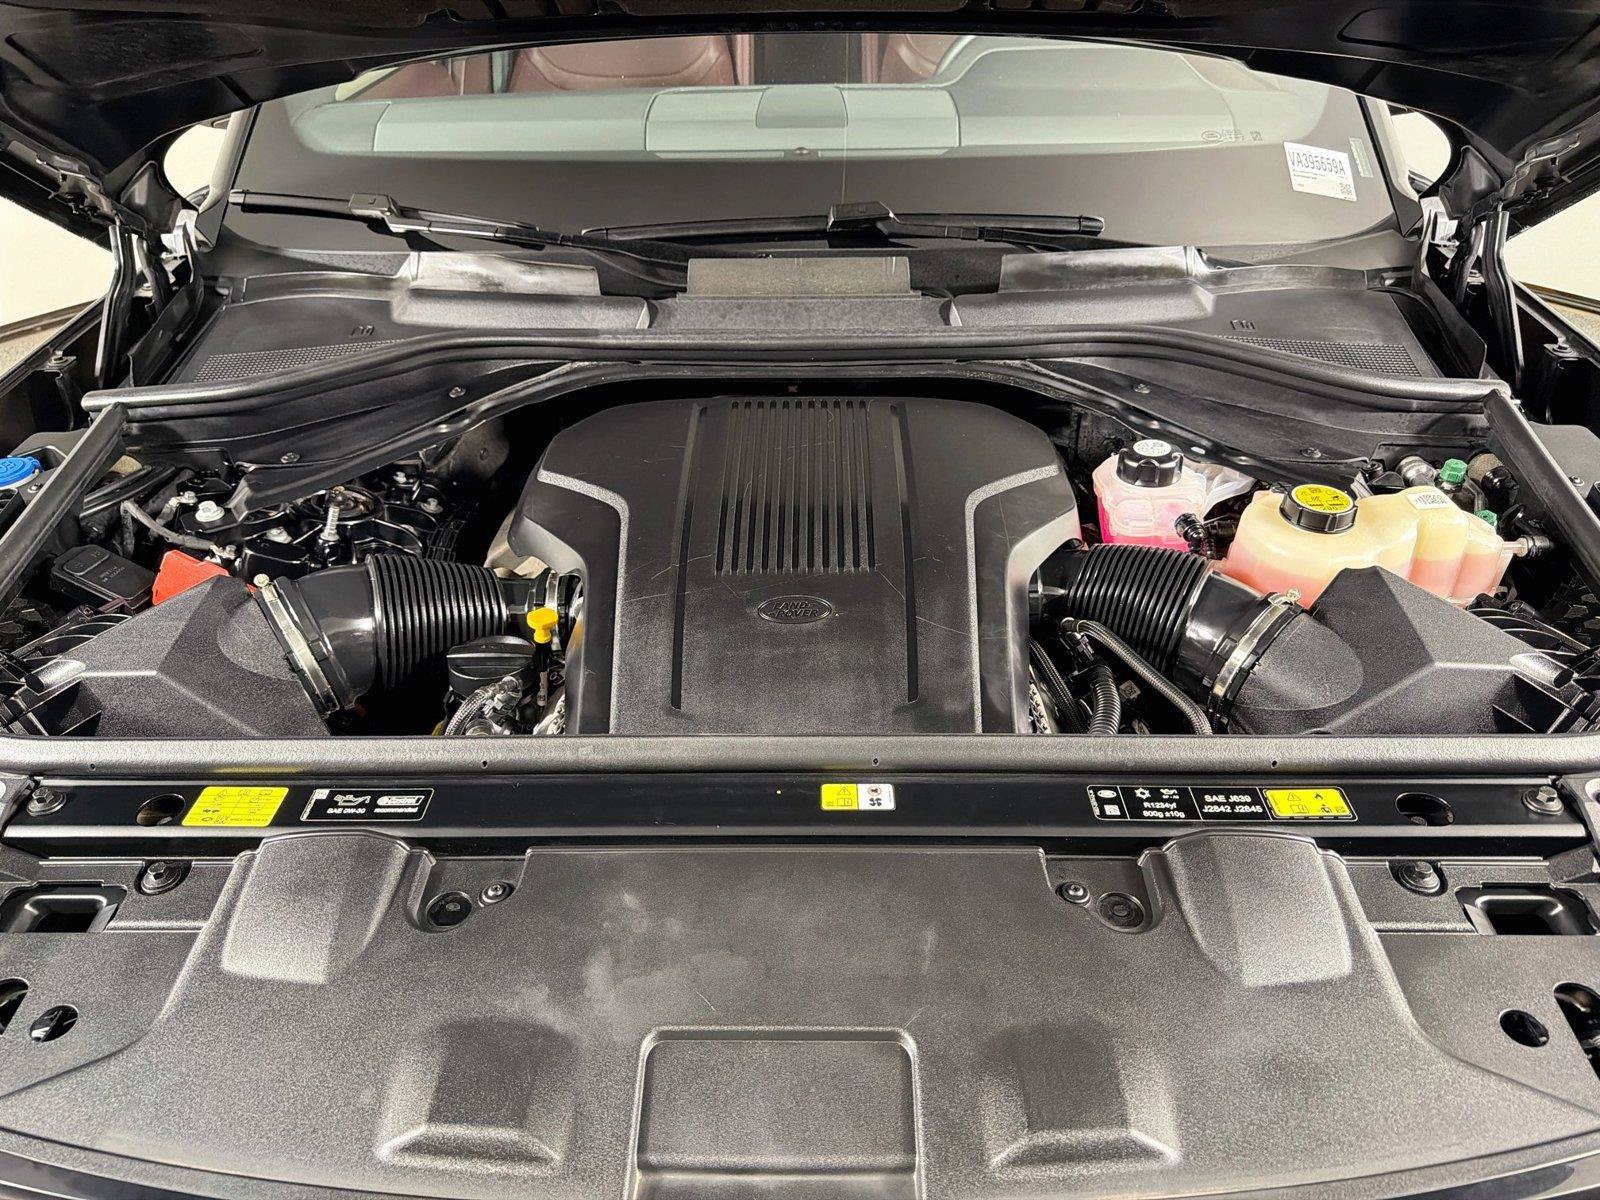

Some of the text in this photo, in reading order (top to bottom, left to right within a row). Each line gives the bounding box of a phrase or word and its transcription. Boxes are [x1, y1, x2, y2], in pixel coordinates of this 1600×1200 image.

[1288, 150, 1346, 176] VA395659A
[773, 601, 810, 610] LAND
[775, 609, 818, 618] ROVER
